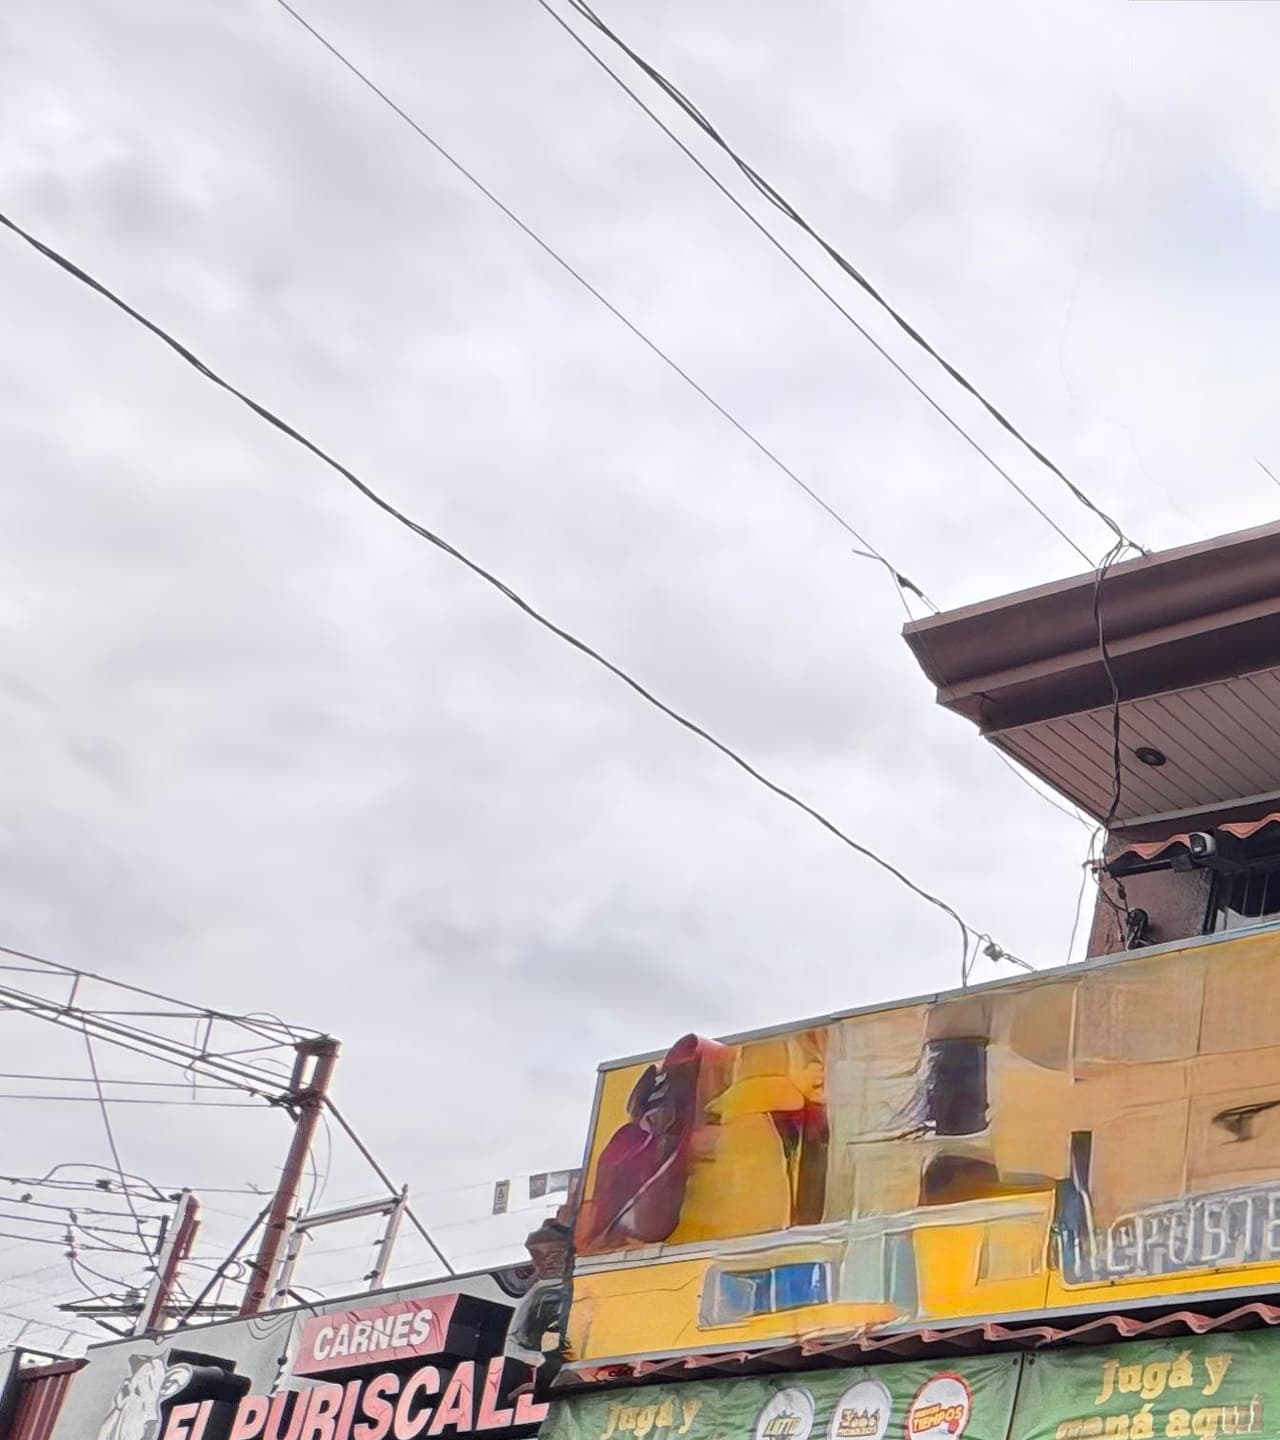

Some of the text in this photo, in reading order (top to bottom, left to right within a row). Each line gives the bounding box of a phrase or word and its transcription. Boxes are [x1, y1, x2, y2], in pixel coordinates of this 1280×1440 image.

[313, 1308, 433, 1362] CARNES
[1202, 1353, 1232, 1396] y
[679, 1399, 702, 1434] y
[912, 1405, 964, 1433] TIEMPOS
